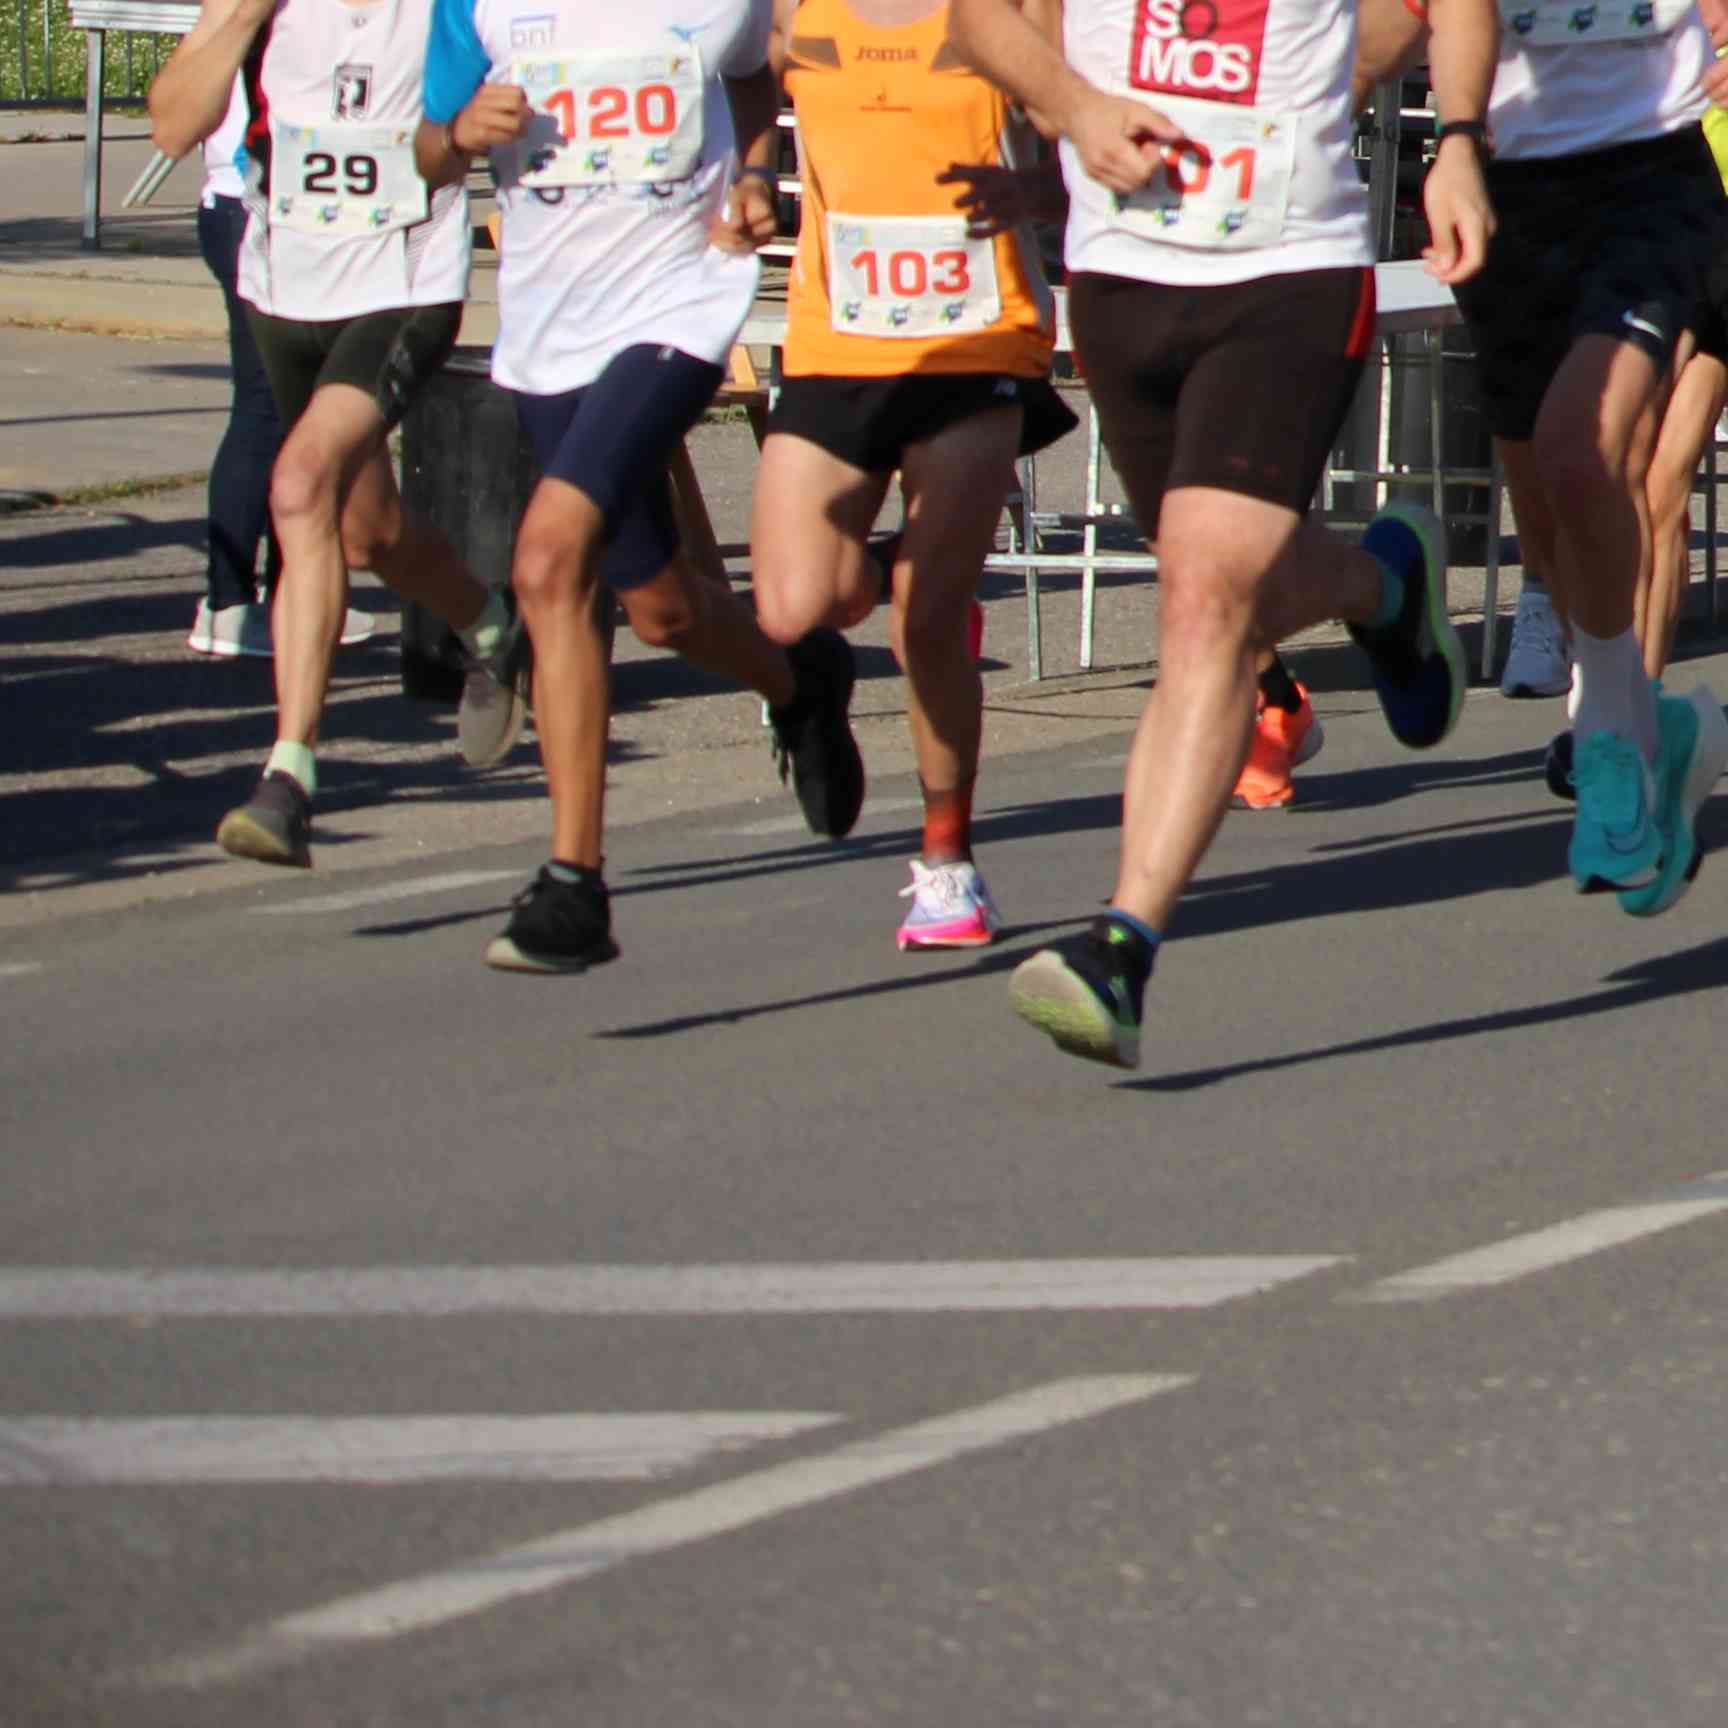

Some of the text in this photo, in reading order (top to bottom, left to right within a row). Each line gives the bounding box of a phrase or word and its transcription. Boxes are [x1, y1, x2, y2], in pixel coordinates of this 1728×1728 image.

[1138, 38, 1253, 92] MOS
[542, 84, 677, 142] 120
[303, 152, 378, 196] 29
[850, 249, 971, 296] 103
